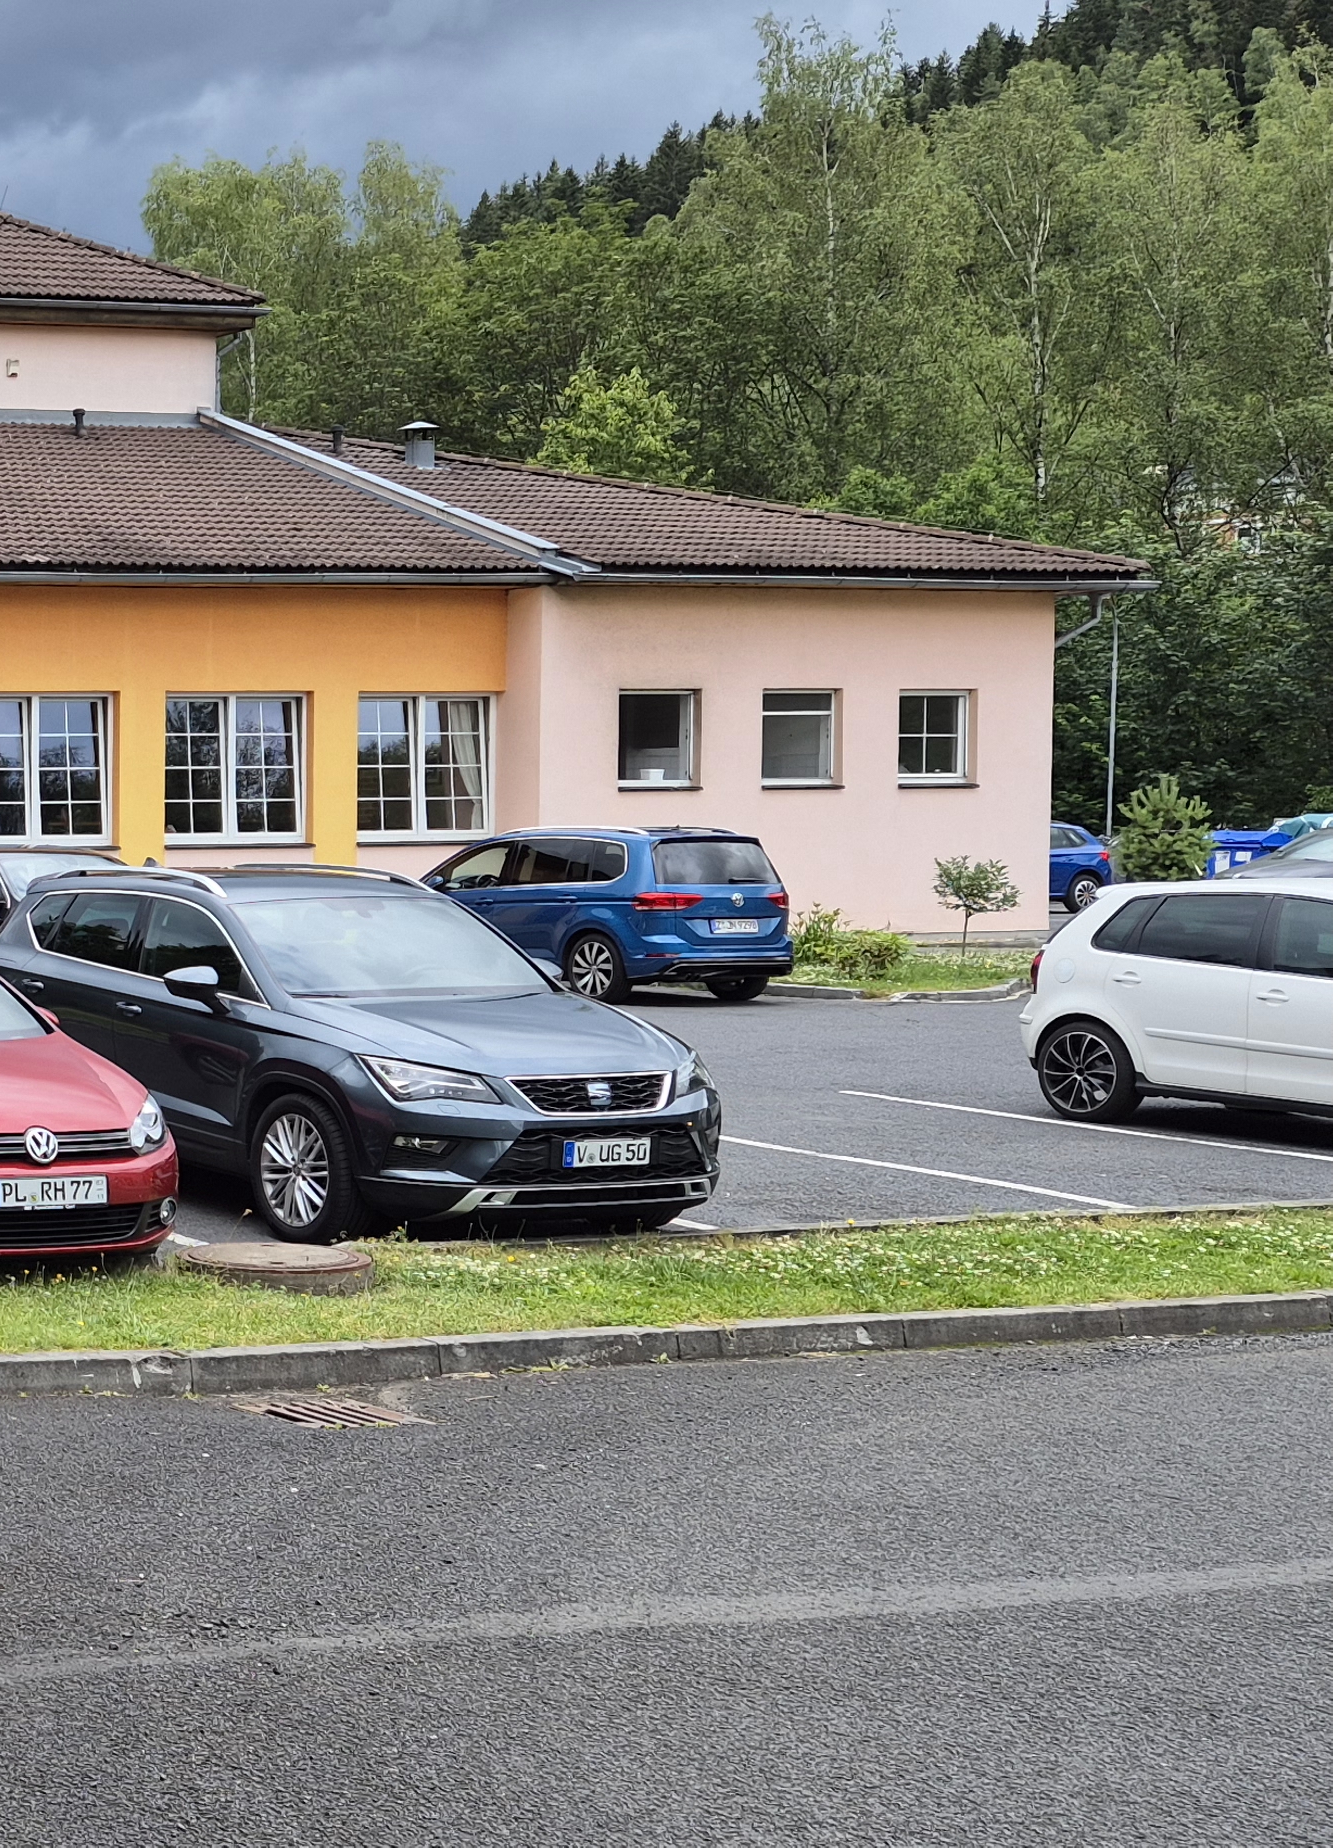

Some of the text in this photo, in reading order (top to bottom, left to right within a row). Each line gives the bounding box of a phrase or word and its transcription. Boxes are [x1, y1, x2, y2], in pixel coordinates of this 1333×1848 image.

[577, 1145, 588, 1164] V
[599, 1144, 622, 1162] UG
[625, 1143, 647, 1162] 50
[1, 1182, 27, 1203] PL
[41, 1180, 66, 1202] RH
[70, 1180, 93, 1200] 77
